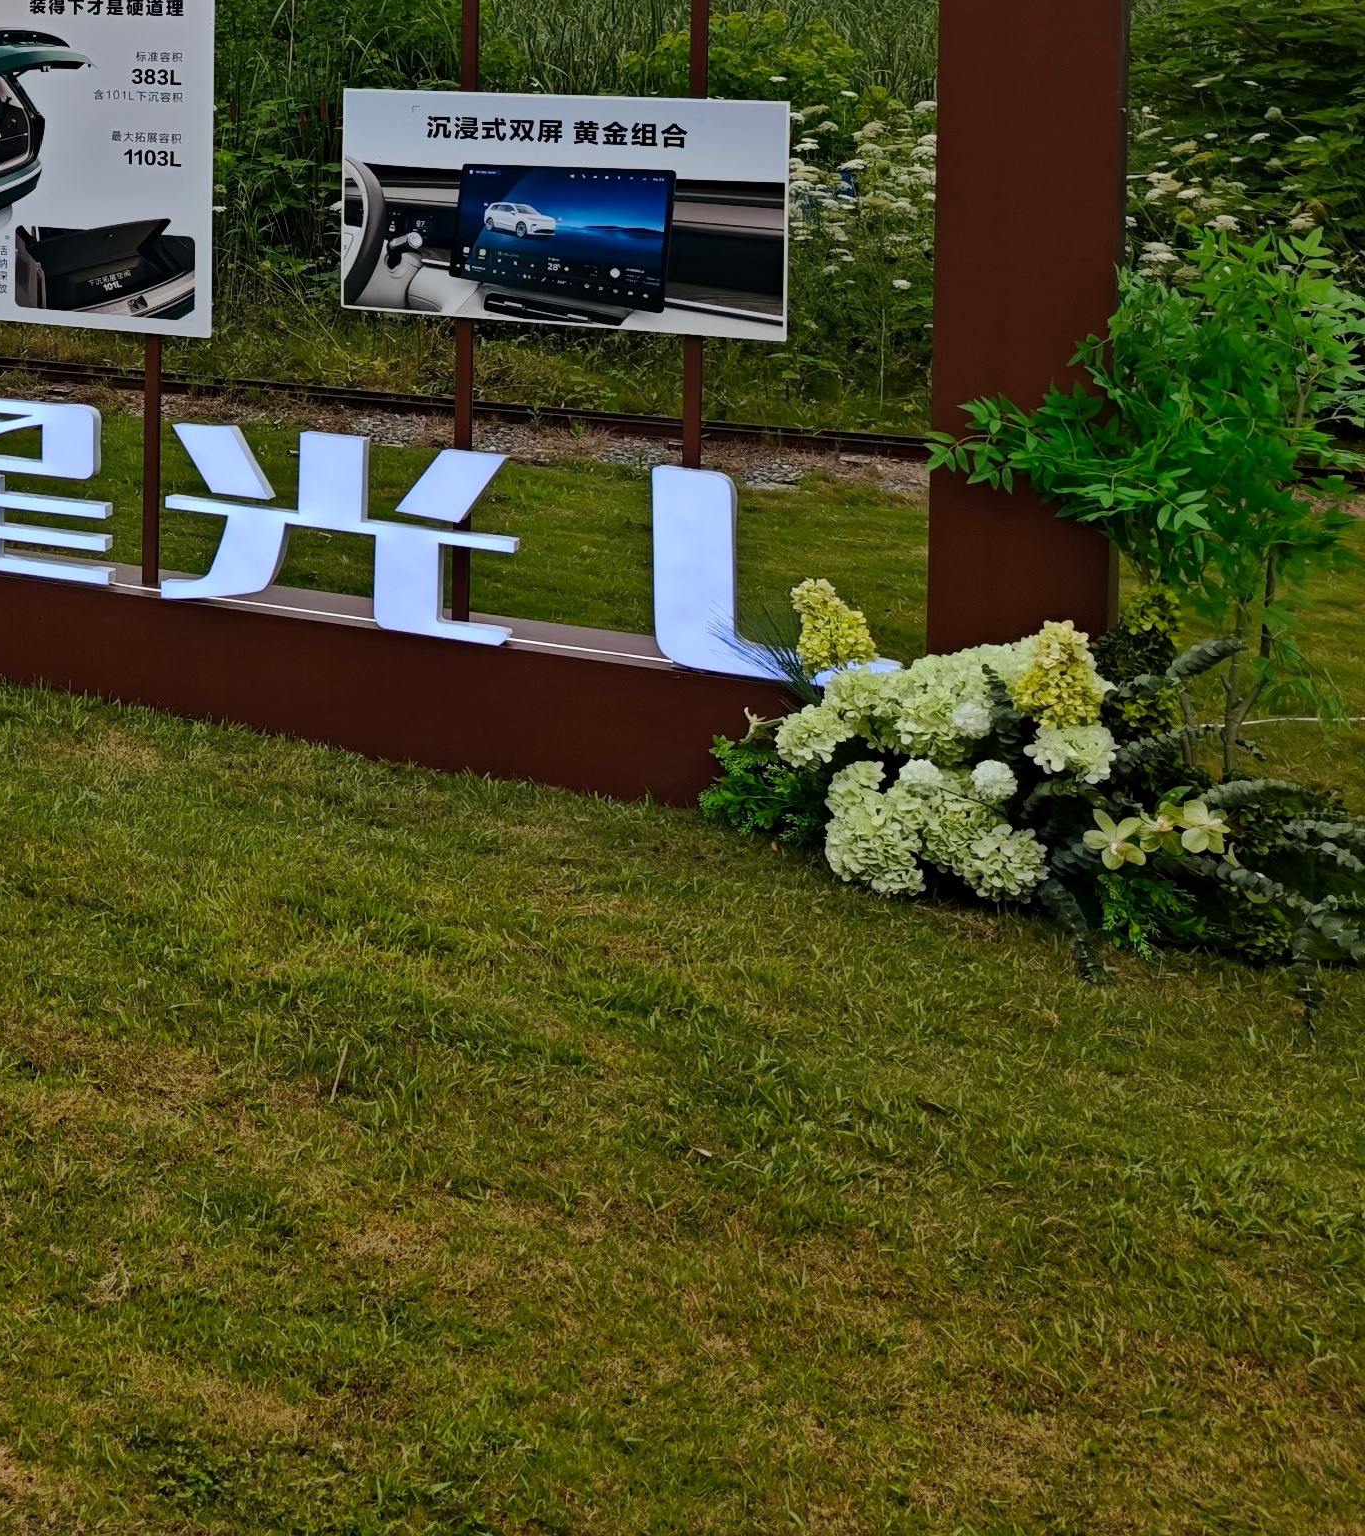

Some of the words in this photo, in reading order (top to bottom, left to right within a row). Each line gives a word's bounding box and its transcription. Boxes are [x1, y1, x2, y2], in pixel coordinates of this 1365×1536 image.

[135, 51, 184, 63] 标准容积
[131, 68, 183, 86] 383L
[93, 89, 184, 104] 含101L下沉容积
[111, 131, 183, 144] 最大拓展容积
[426, 115, 563, 144] 沉浸式双屏
[573, 120, 688, 150] 黄金组合
[123, 149, 183, 168] 1103L
[103, 282, 123, 292] 101L
